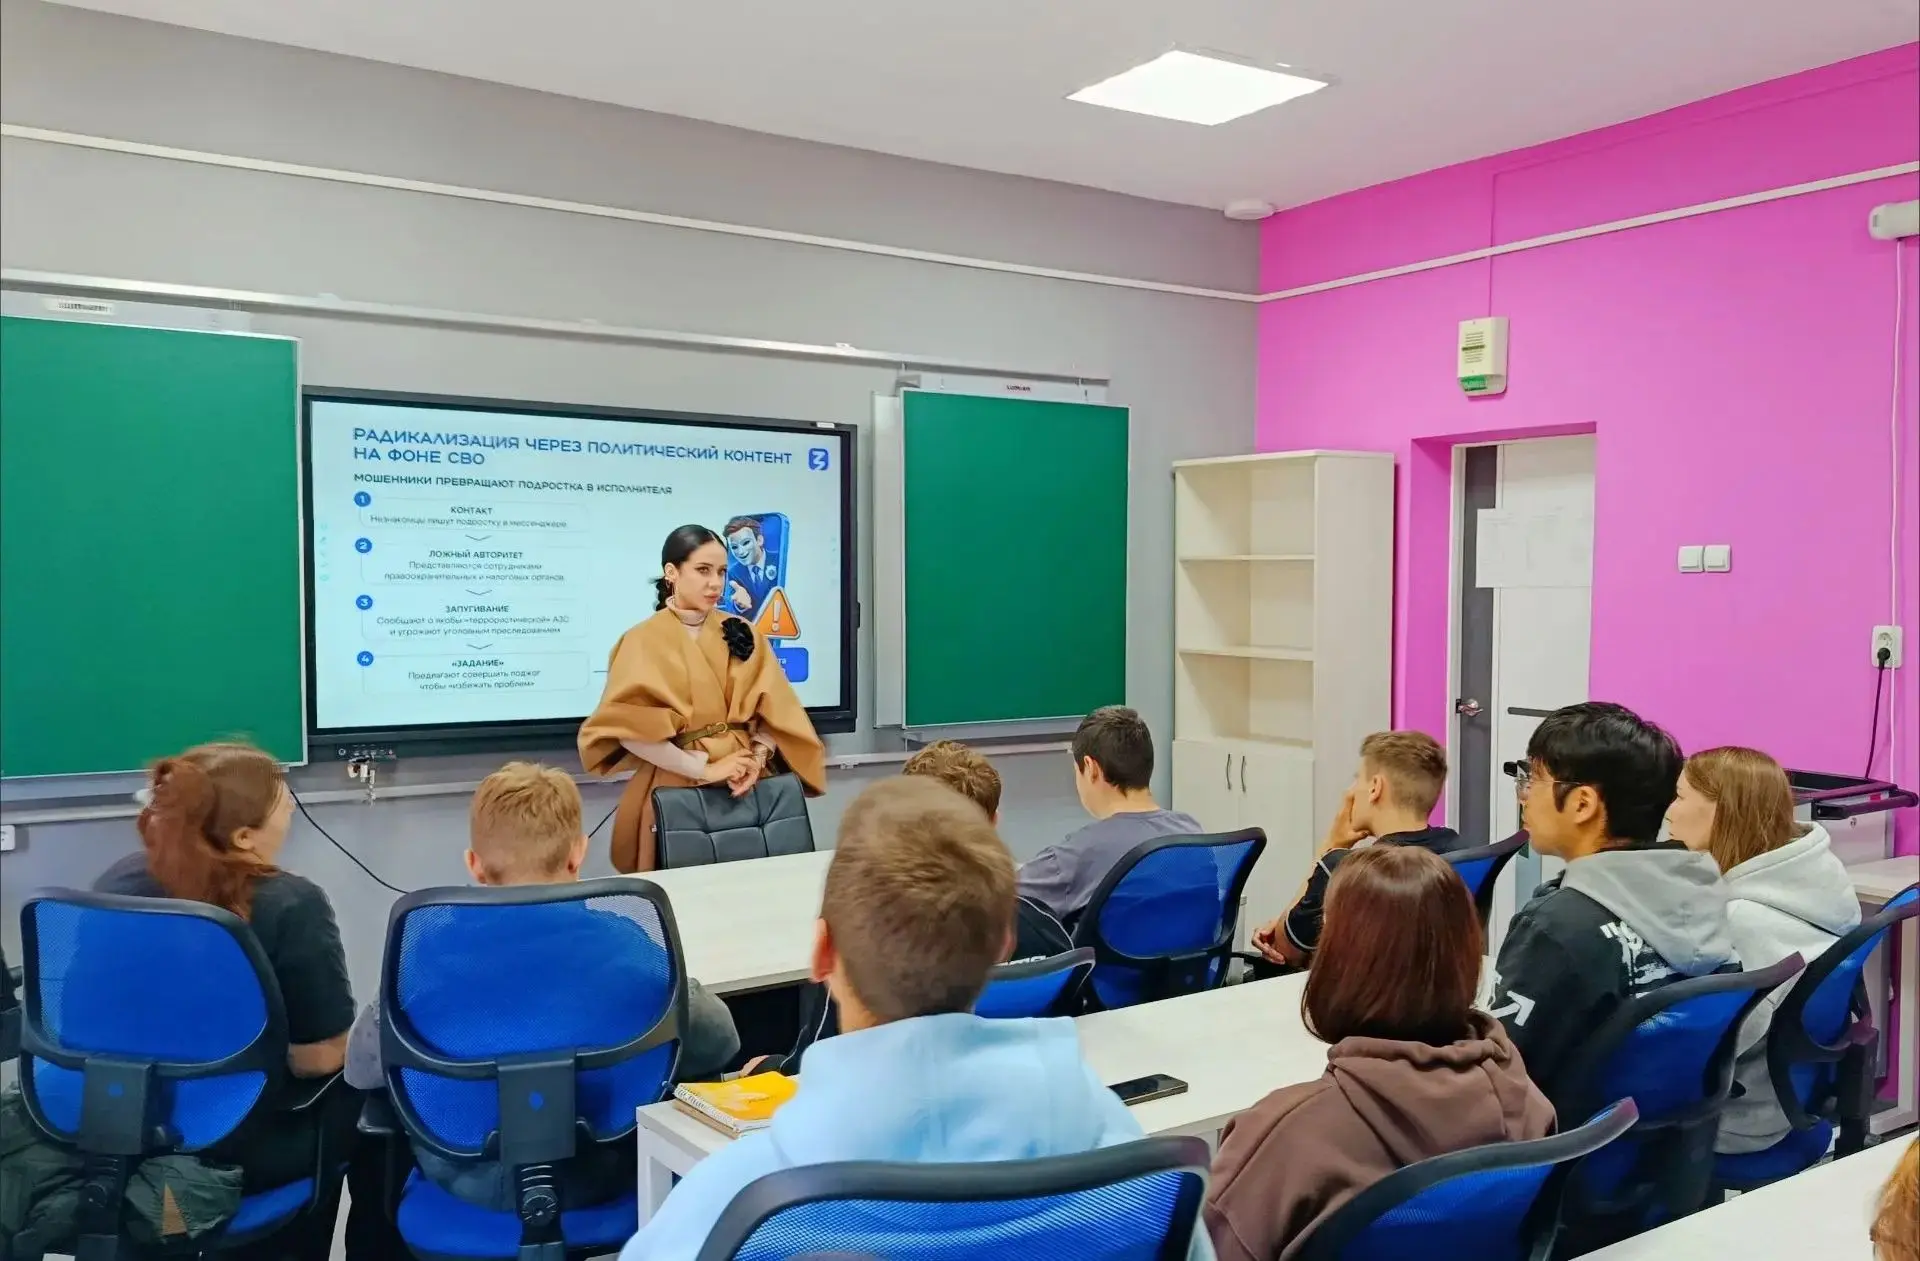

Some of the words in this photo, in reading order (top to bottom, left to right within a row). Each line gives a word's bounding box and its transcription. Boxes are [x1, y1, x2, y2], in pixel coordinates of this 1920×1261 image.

[354, 428, 519, 449] РАДИКАЛИЗАЦИЯ
[526, 438, 582, 452] ЧЕРЕЗ
[588, 441, 718, 460] ПОЛИТИЧЕСКИЙ
[725, 450, 792, 464] КОНТЕНТ
[354, 447, 381, 461] НА
[388, 449, 441, 463] ФОНЕ
[448, 452, 485, 465] СВО
[354, 474, 432, 485] МОШЕННИКИ
[436, 477, 515, 488] ПРЕВРАЩАЮТ
[519, 481, 584, 491] ПОДРОСТКА
[587, 483, 594, 492] В
[597, 484, 673, 495] ИСПОЛНИТЕЛЯ
[451, 506, 492, 515] КОНТАКТ
[429, 549, 470, 558] ЛОЖНЫЙ
[473, 551, 523, 559] АВТОРИТЕТ
[445, 605, 509, 613] ЗАПУГИВАНИЕ
[452, 659, 504, 668] «ЗАДАНИЕ»
[420, 682, 446, 690] чтобы
